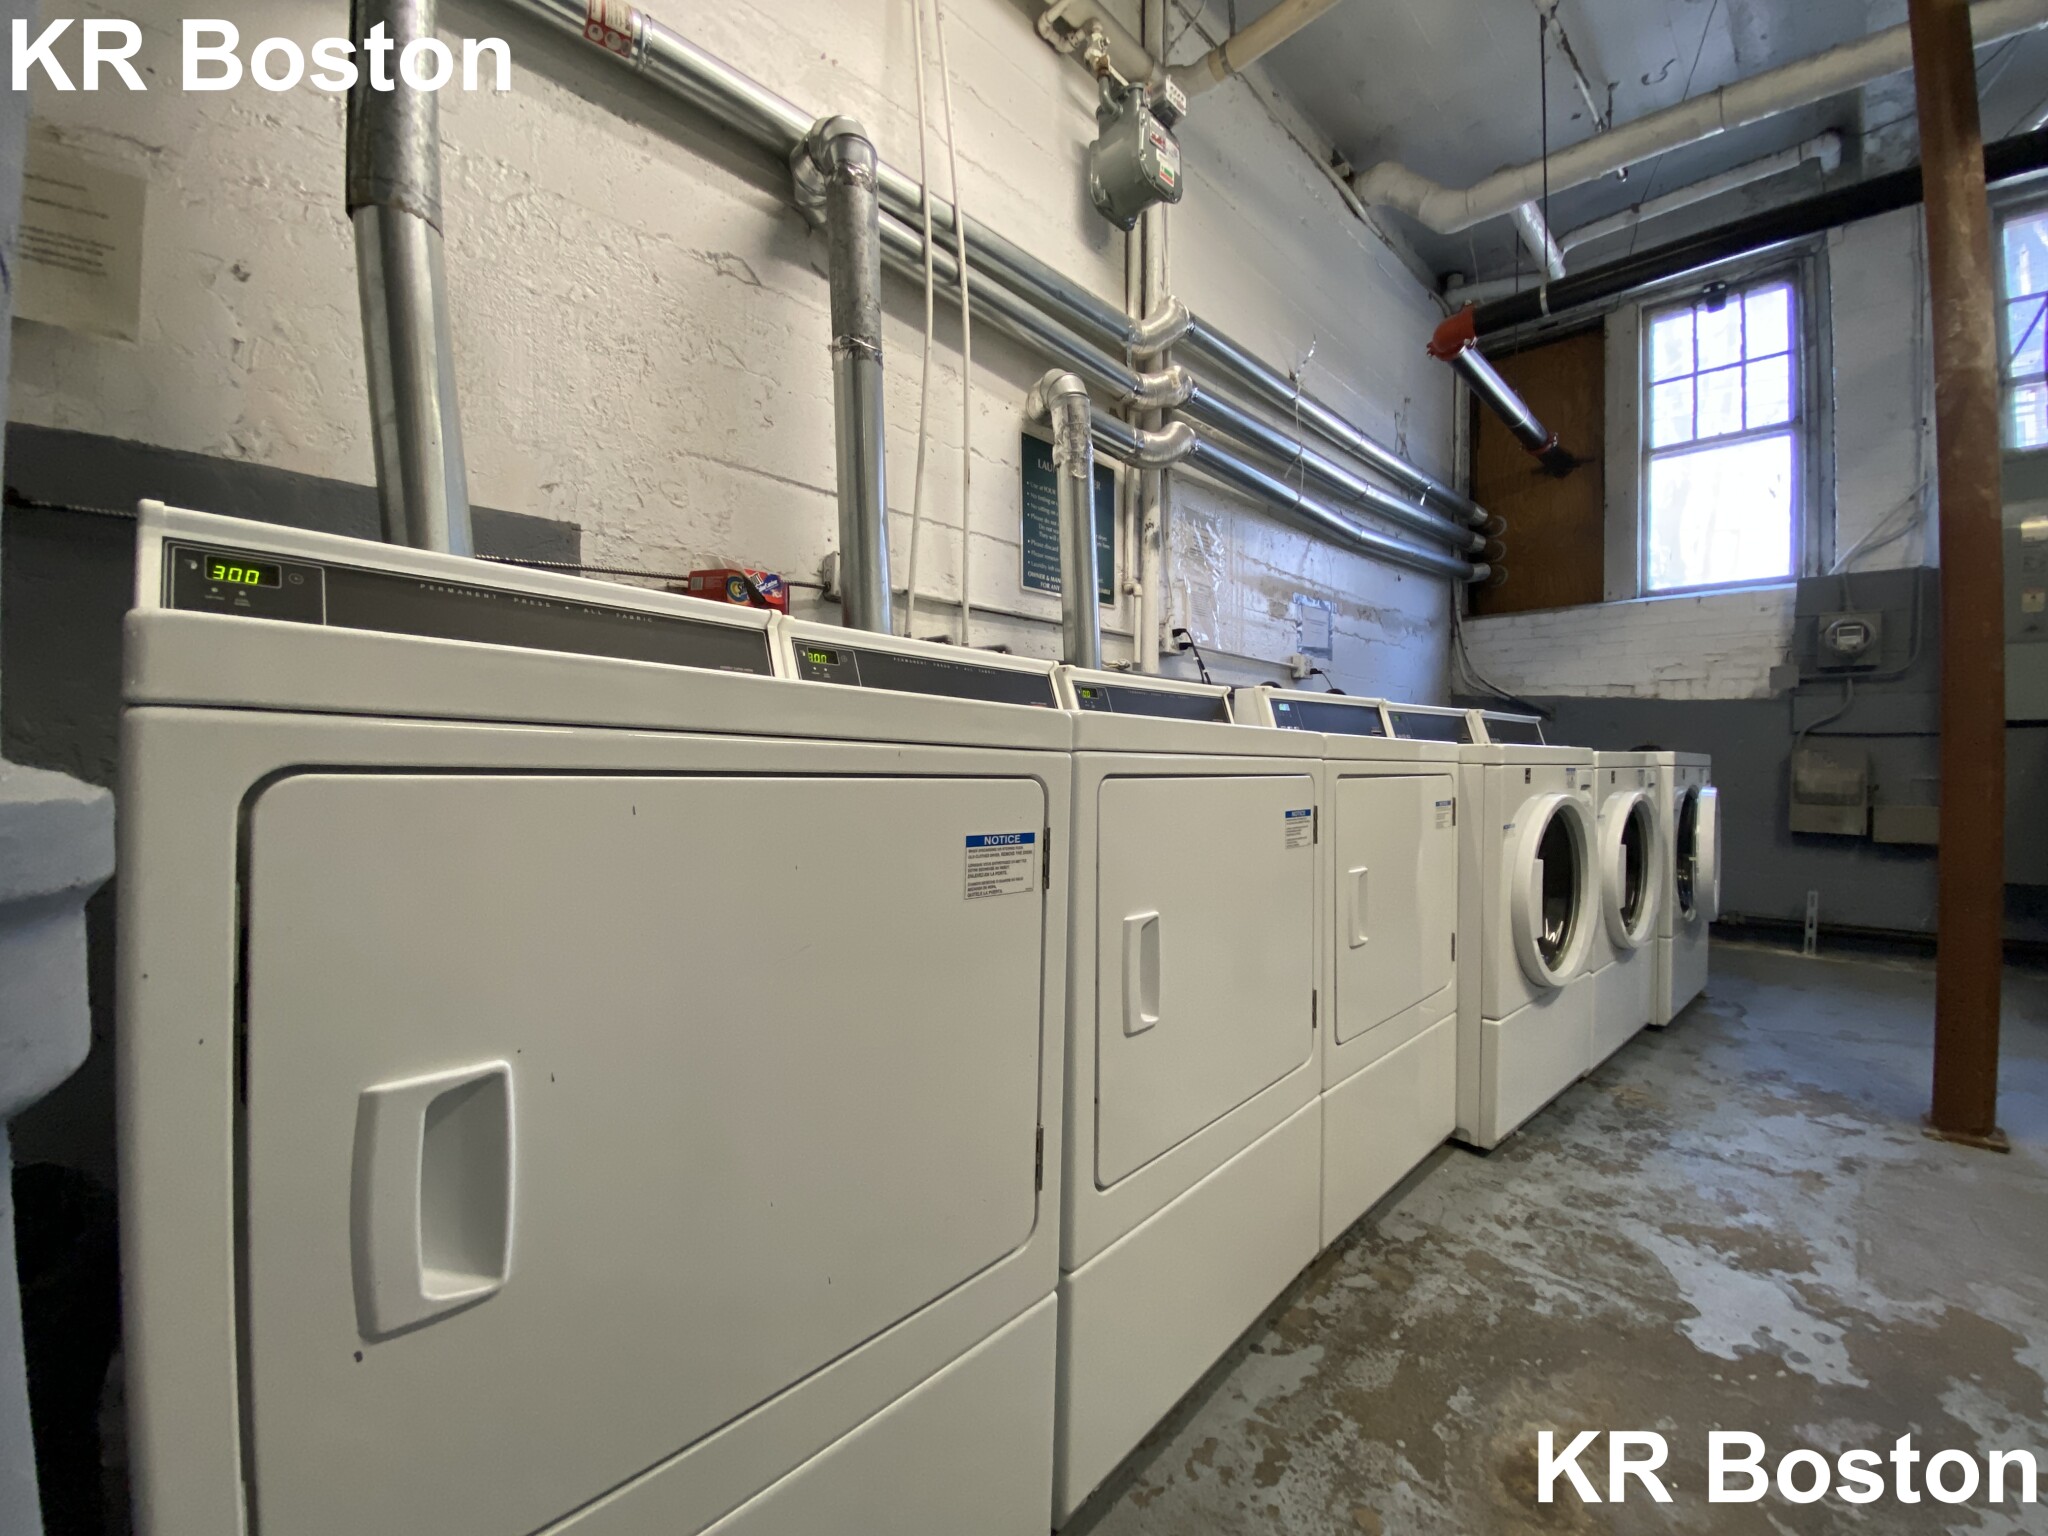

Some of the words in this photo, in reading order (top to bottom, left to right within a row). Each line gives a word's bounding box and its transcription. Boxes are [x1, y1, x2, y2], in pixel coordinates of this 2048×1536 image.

[213, 565, 260, 585] 300
[420, 583, 498, 599] PERMANENT
[513, 597, 551, 608] PRESS
[583, 607, 603, 616] ALL
[616, 612, 653, 623] FABRIC
[984, 835, 1021, 845] NOTICE
